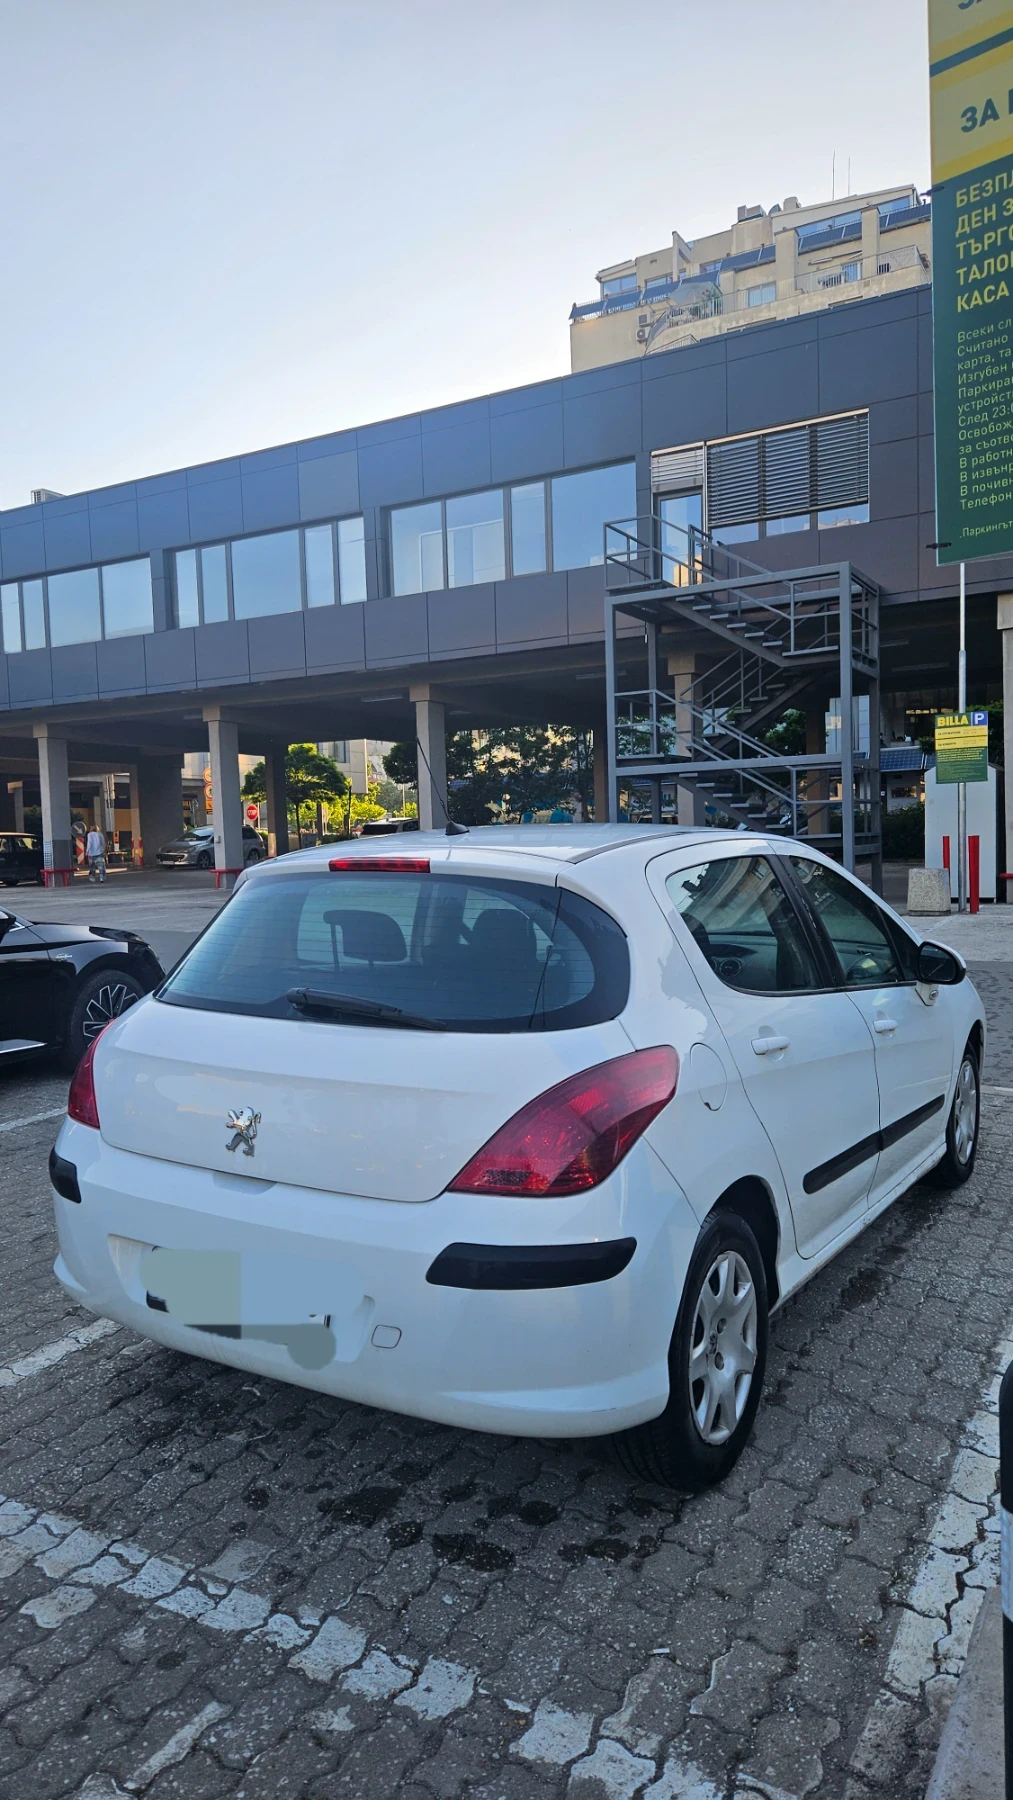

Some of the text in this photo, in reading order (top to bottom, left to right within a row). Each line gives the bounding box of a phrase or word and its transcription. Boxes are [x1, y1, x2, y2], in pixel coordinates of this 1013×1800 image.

[960, 98, 1000, 133] ЗА
[955, 203, 996, 238] ДЕН
[956, 250, 1013, 286] ТАЛО
[957, 280, 1010, 313] КАСА
[957, 324, 994, 343] Всеки
[957, 334, 1008, 357] Считано
[957, 354, 995, 371] карта,
[958, 363, 1007, 385] Изгубен
[958, 376, 1013, 399] Паркира
[957, 390, 1013, 416] устройст
[958, 412, 989, 427] След
[958, 420, 1013, 441] Освобож
[959, 444, 972, 455] за
[959, 457, 967, 469] В
[960, 471, 968, 483] В
[960, 485, 968, 497] В
[960, 491, 1012, 510] Телефон
[937, 713, 985, 727] BILLA P
